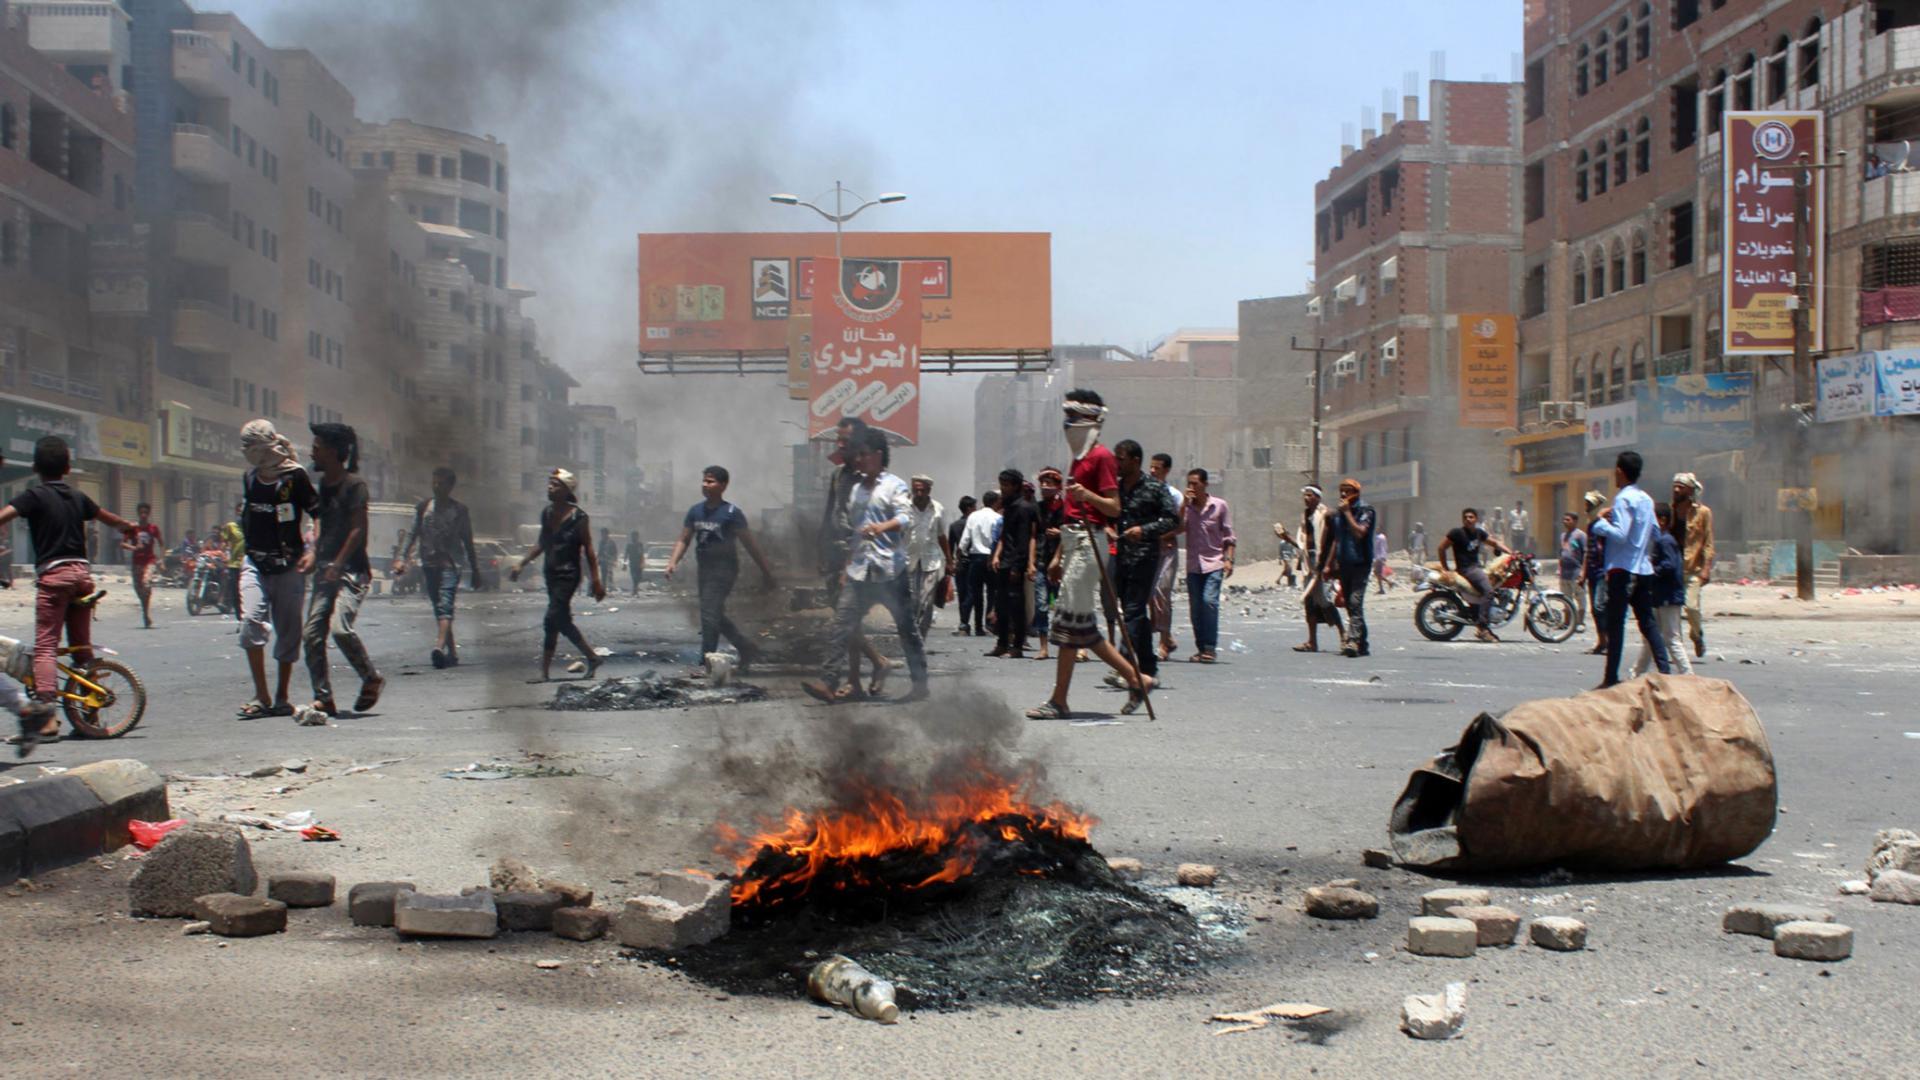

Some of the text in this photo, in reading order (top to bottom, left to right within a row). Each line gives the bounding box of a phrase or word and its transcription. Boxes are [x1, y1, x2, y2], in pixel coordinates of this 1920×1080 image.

[755, 306, 788, 317] NCC
[842, 327, 896, 343] مخازن
[813, 343, 917, 376] الحريري
